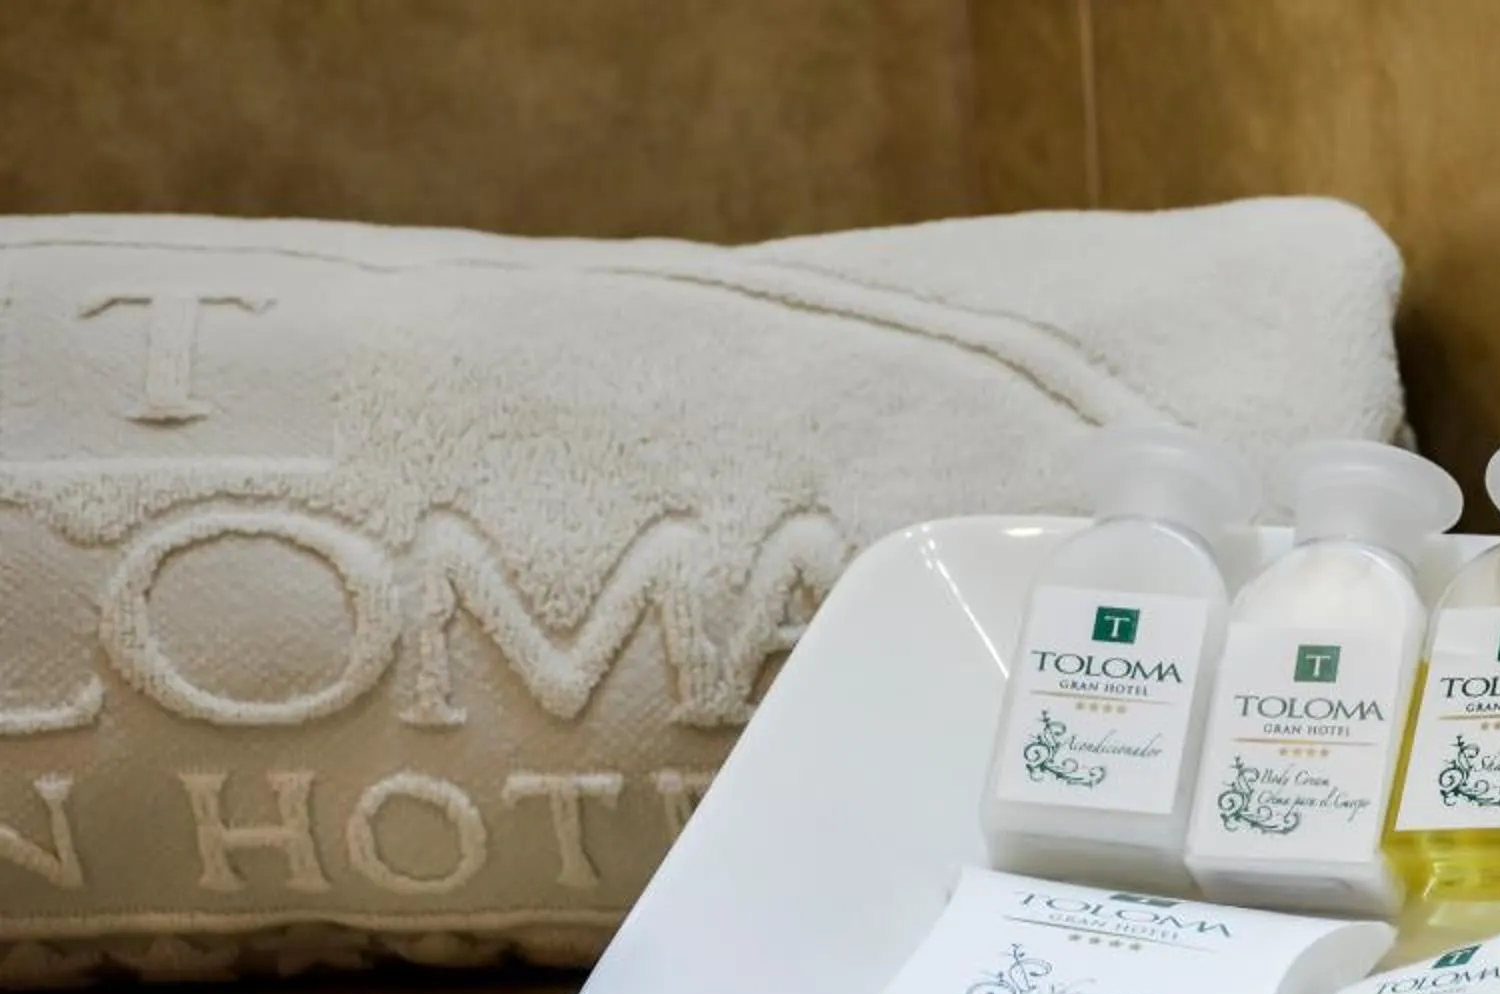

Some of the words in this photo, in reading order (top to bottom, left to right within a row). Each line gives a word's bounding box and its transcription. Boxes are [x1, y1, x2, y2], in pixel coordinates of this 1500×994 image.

[76, 294, 276, 429] T
[0, 496, 848, 734] OMA
[1103, 615, 1131, 638] T
[1031, 650, 1183, 683] TOLOMA
[1305, 654, 1331, 678] T
[1059, 680, 1098, 693] GRAN
[1104, 683, 1149, 697] HOTEL
[1234, 694, 1384, 722] TOLOMA
[1263, 723, 1300, 735] GRAN
[1307, 725, 1350, 737] HOTEL
[178, 768, 712, 892] HOT
[1015, 890, 1232, 938] TOLOMA
